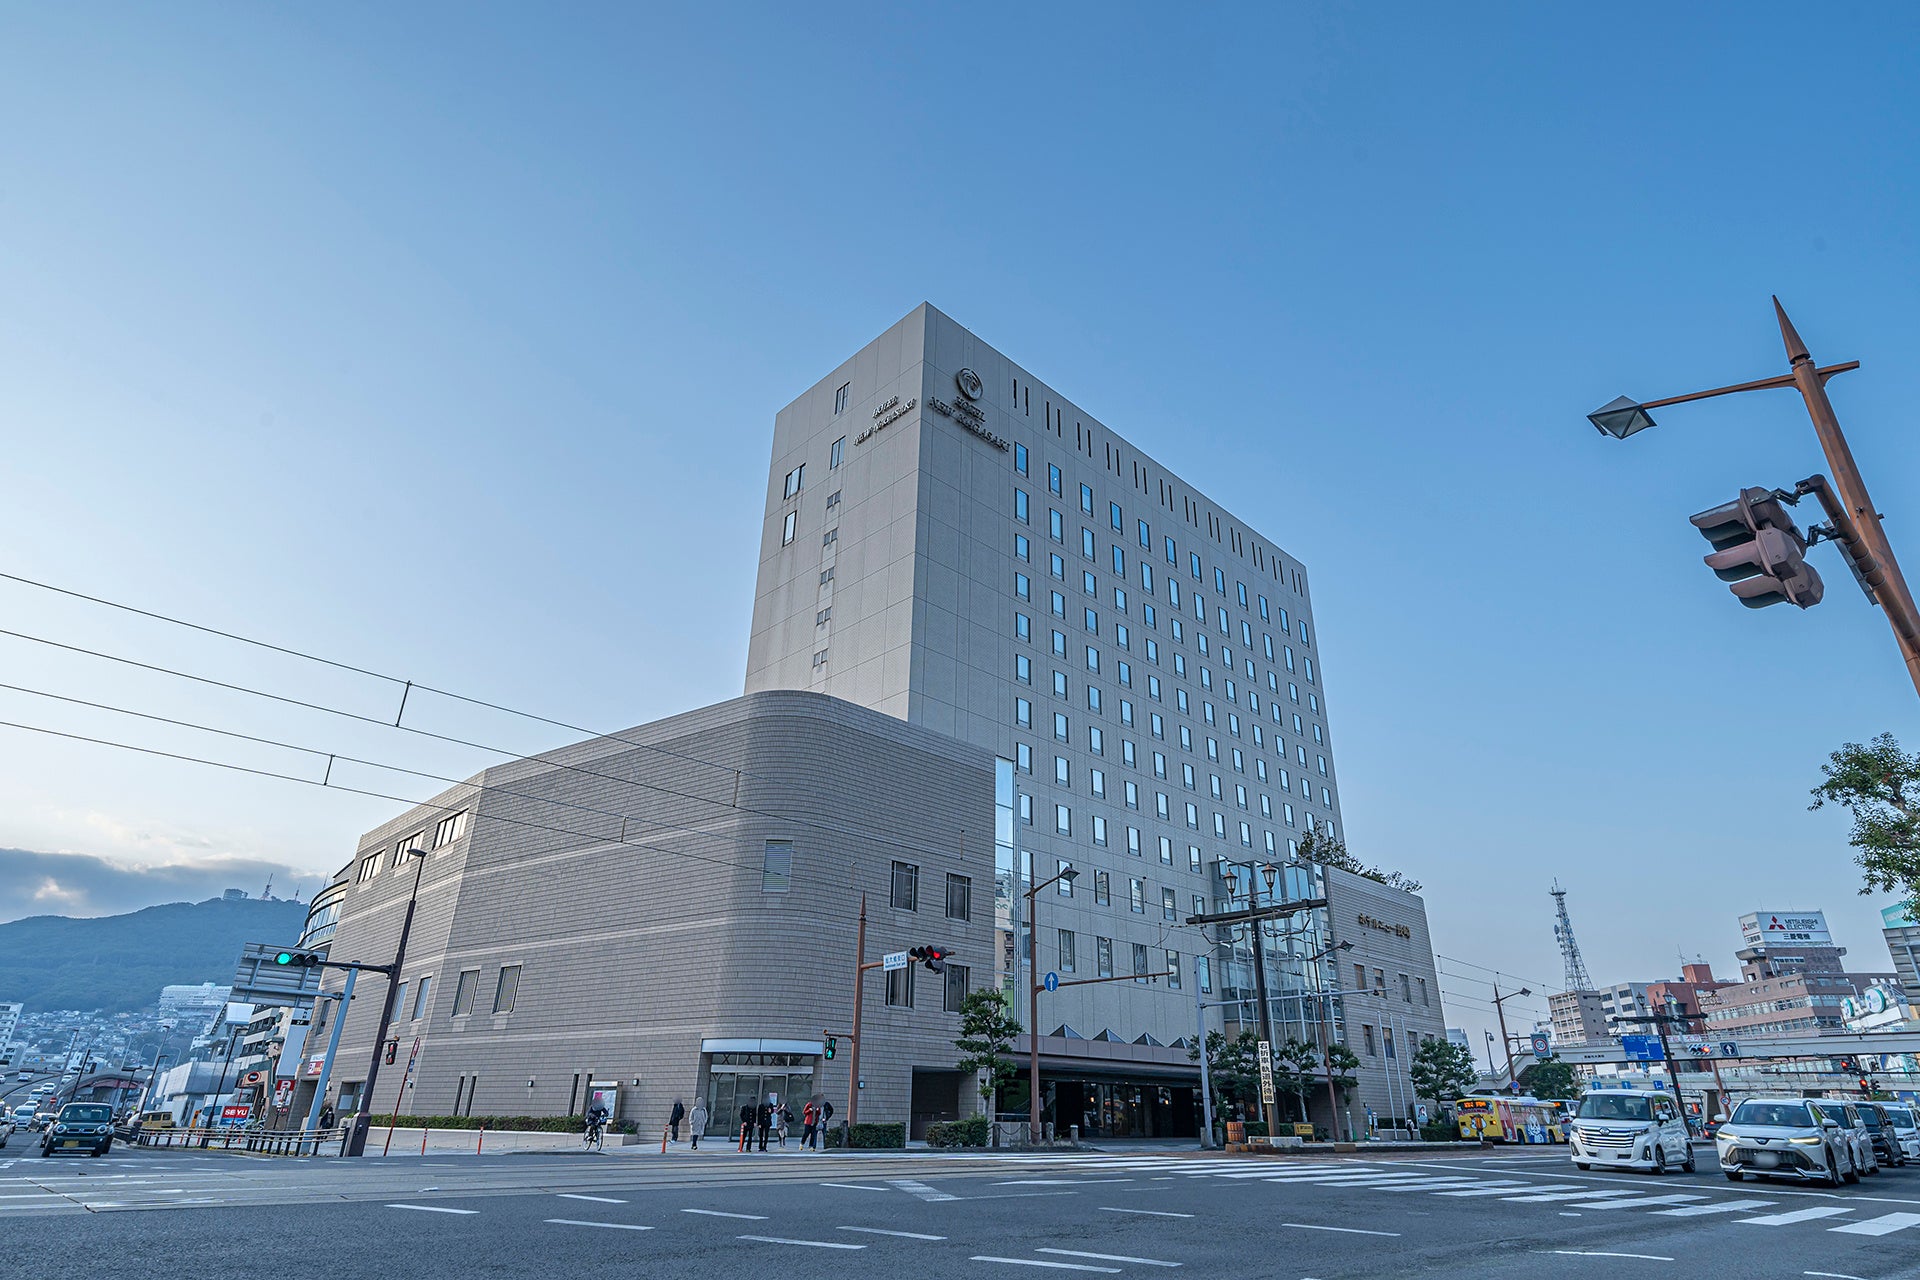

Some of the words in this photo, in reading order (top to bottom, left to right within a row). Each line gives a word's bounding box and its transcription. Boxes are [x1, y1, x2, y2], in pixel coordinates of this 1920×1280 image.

[929, 397, 956, 416] NEW
[957, 413, 1011, 452] NAGASAKI
[955, 397, 986, 422] HOTEL
